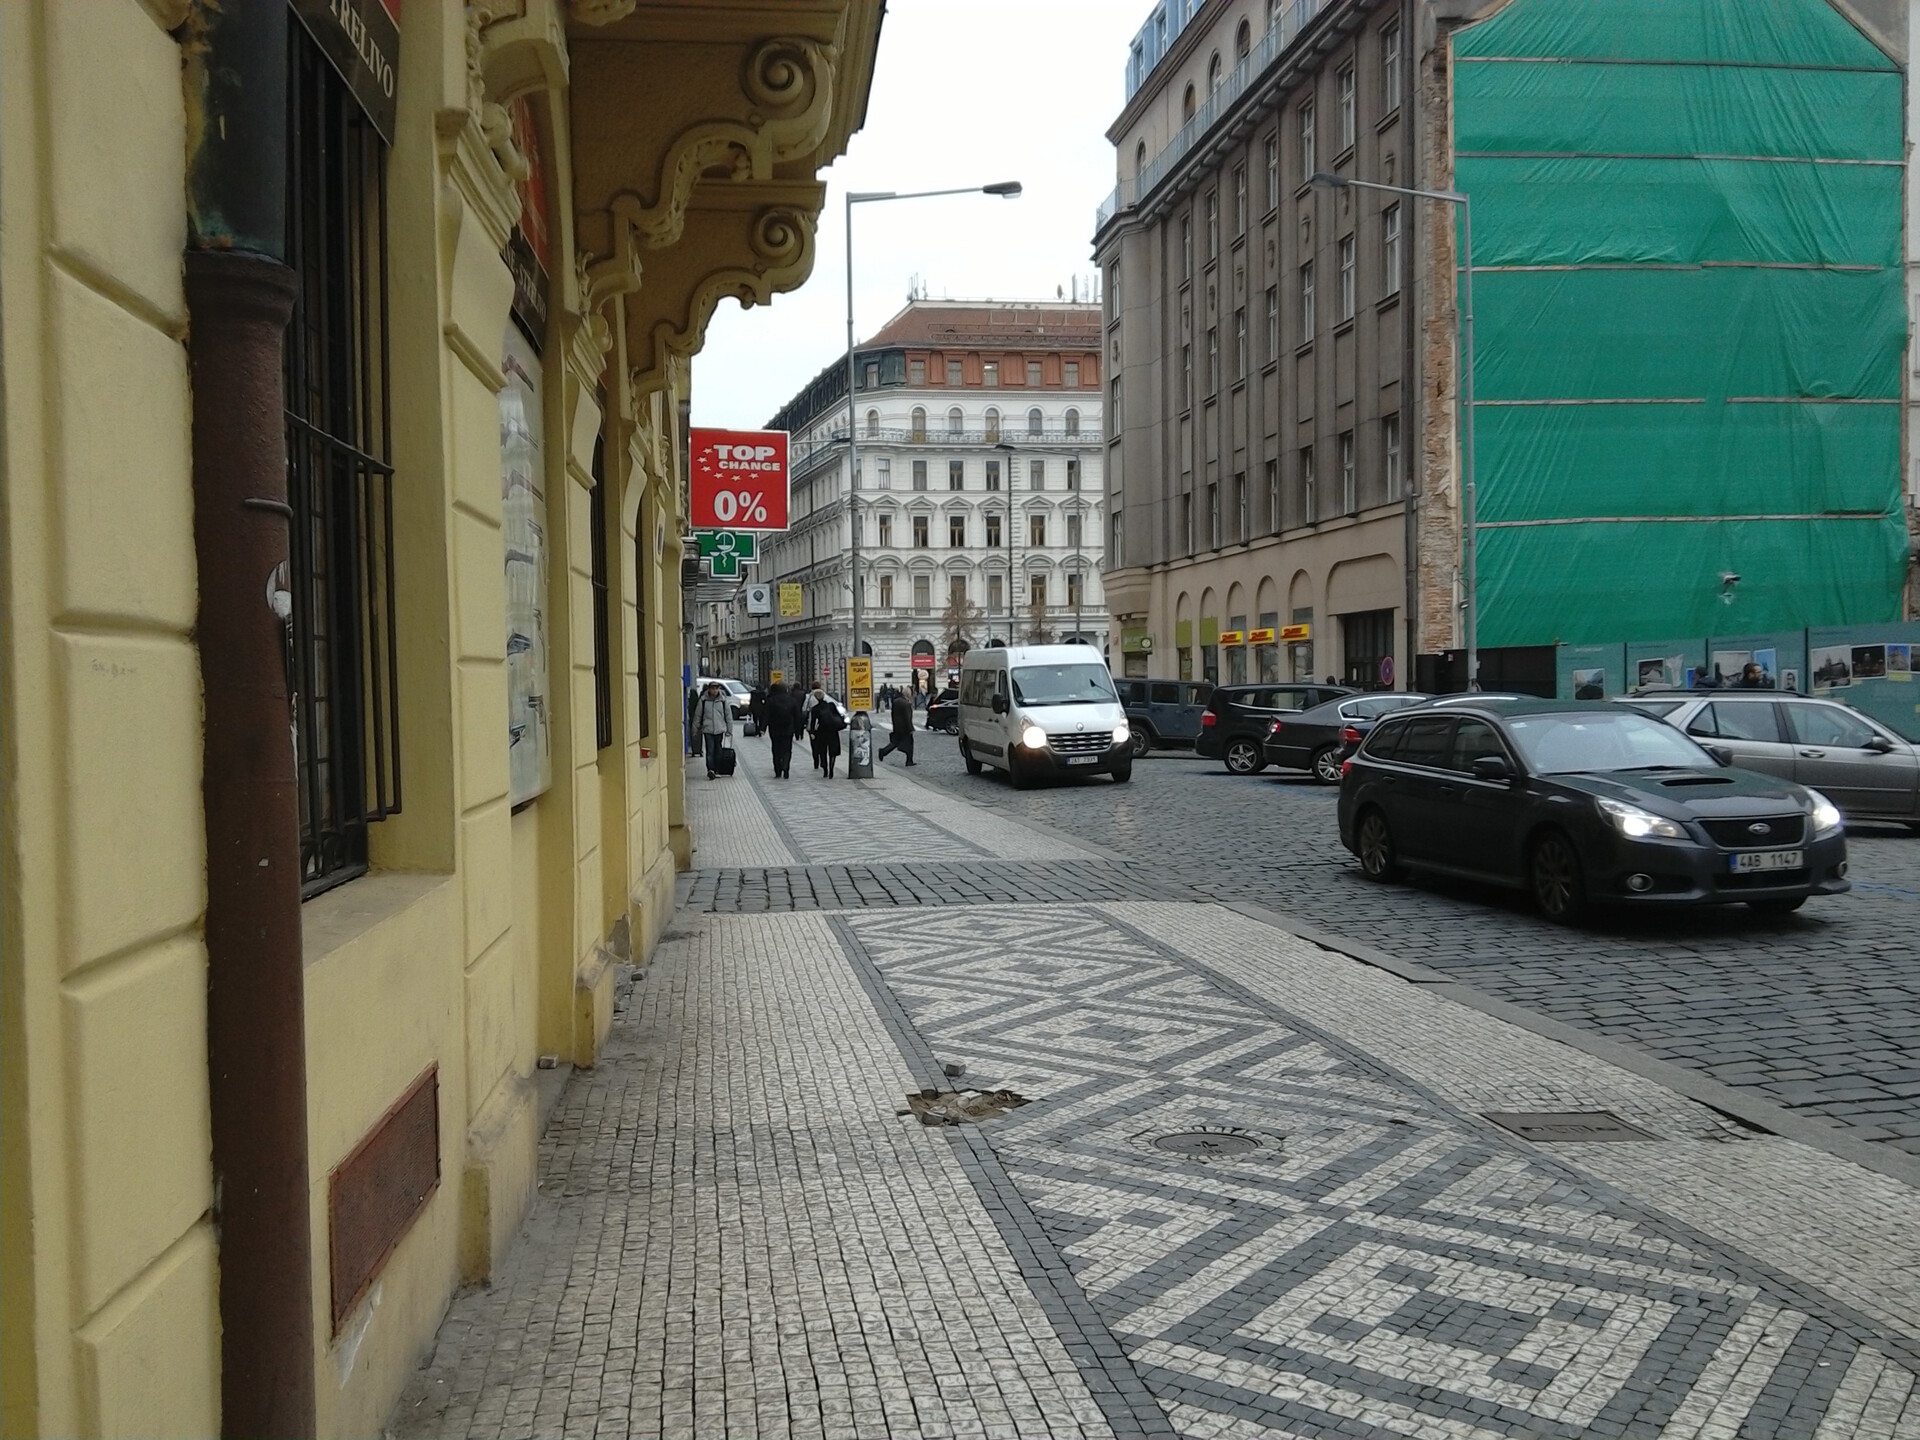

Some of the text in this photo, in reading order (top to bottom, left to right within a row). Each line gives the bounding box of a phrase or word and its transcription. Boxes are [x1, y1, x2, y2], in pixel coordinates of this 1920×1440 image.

[713, 444, 776, 461] TOP
[718, 460, 781, 471] CHANGE
[714, 490, 767, 522] 0%
[1740, 852, 1798, 867] 4AB 1147
